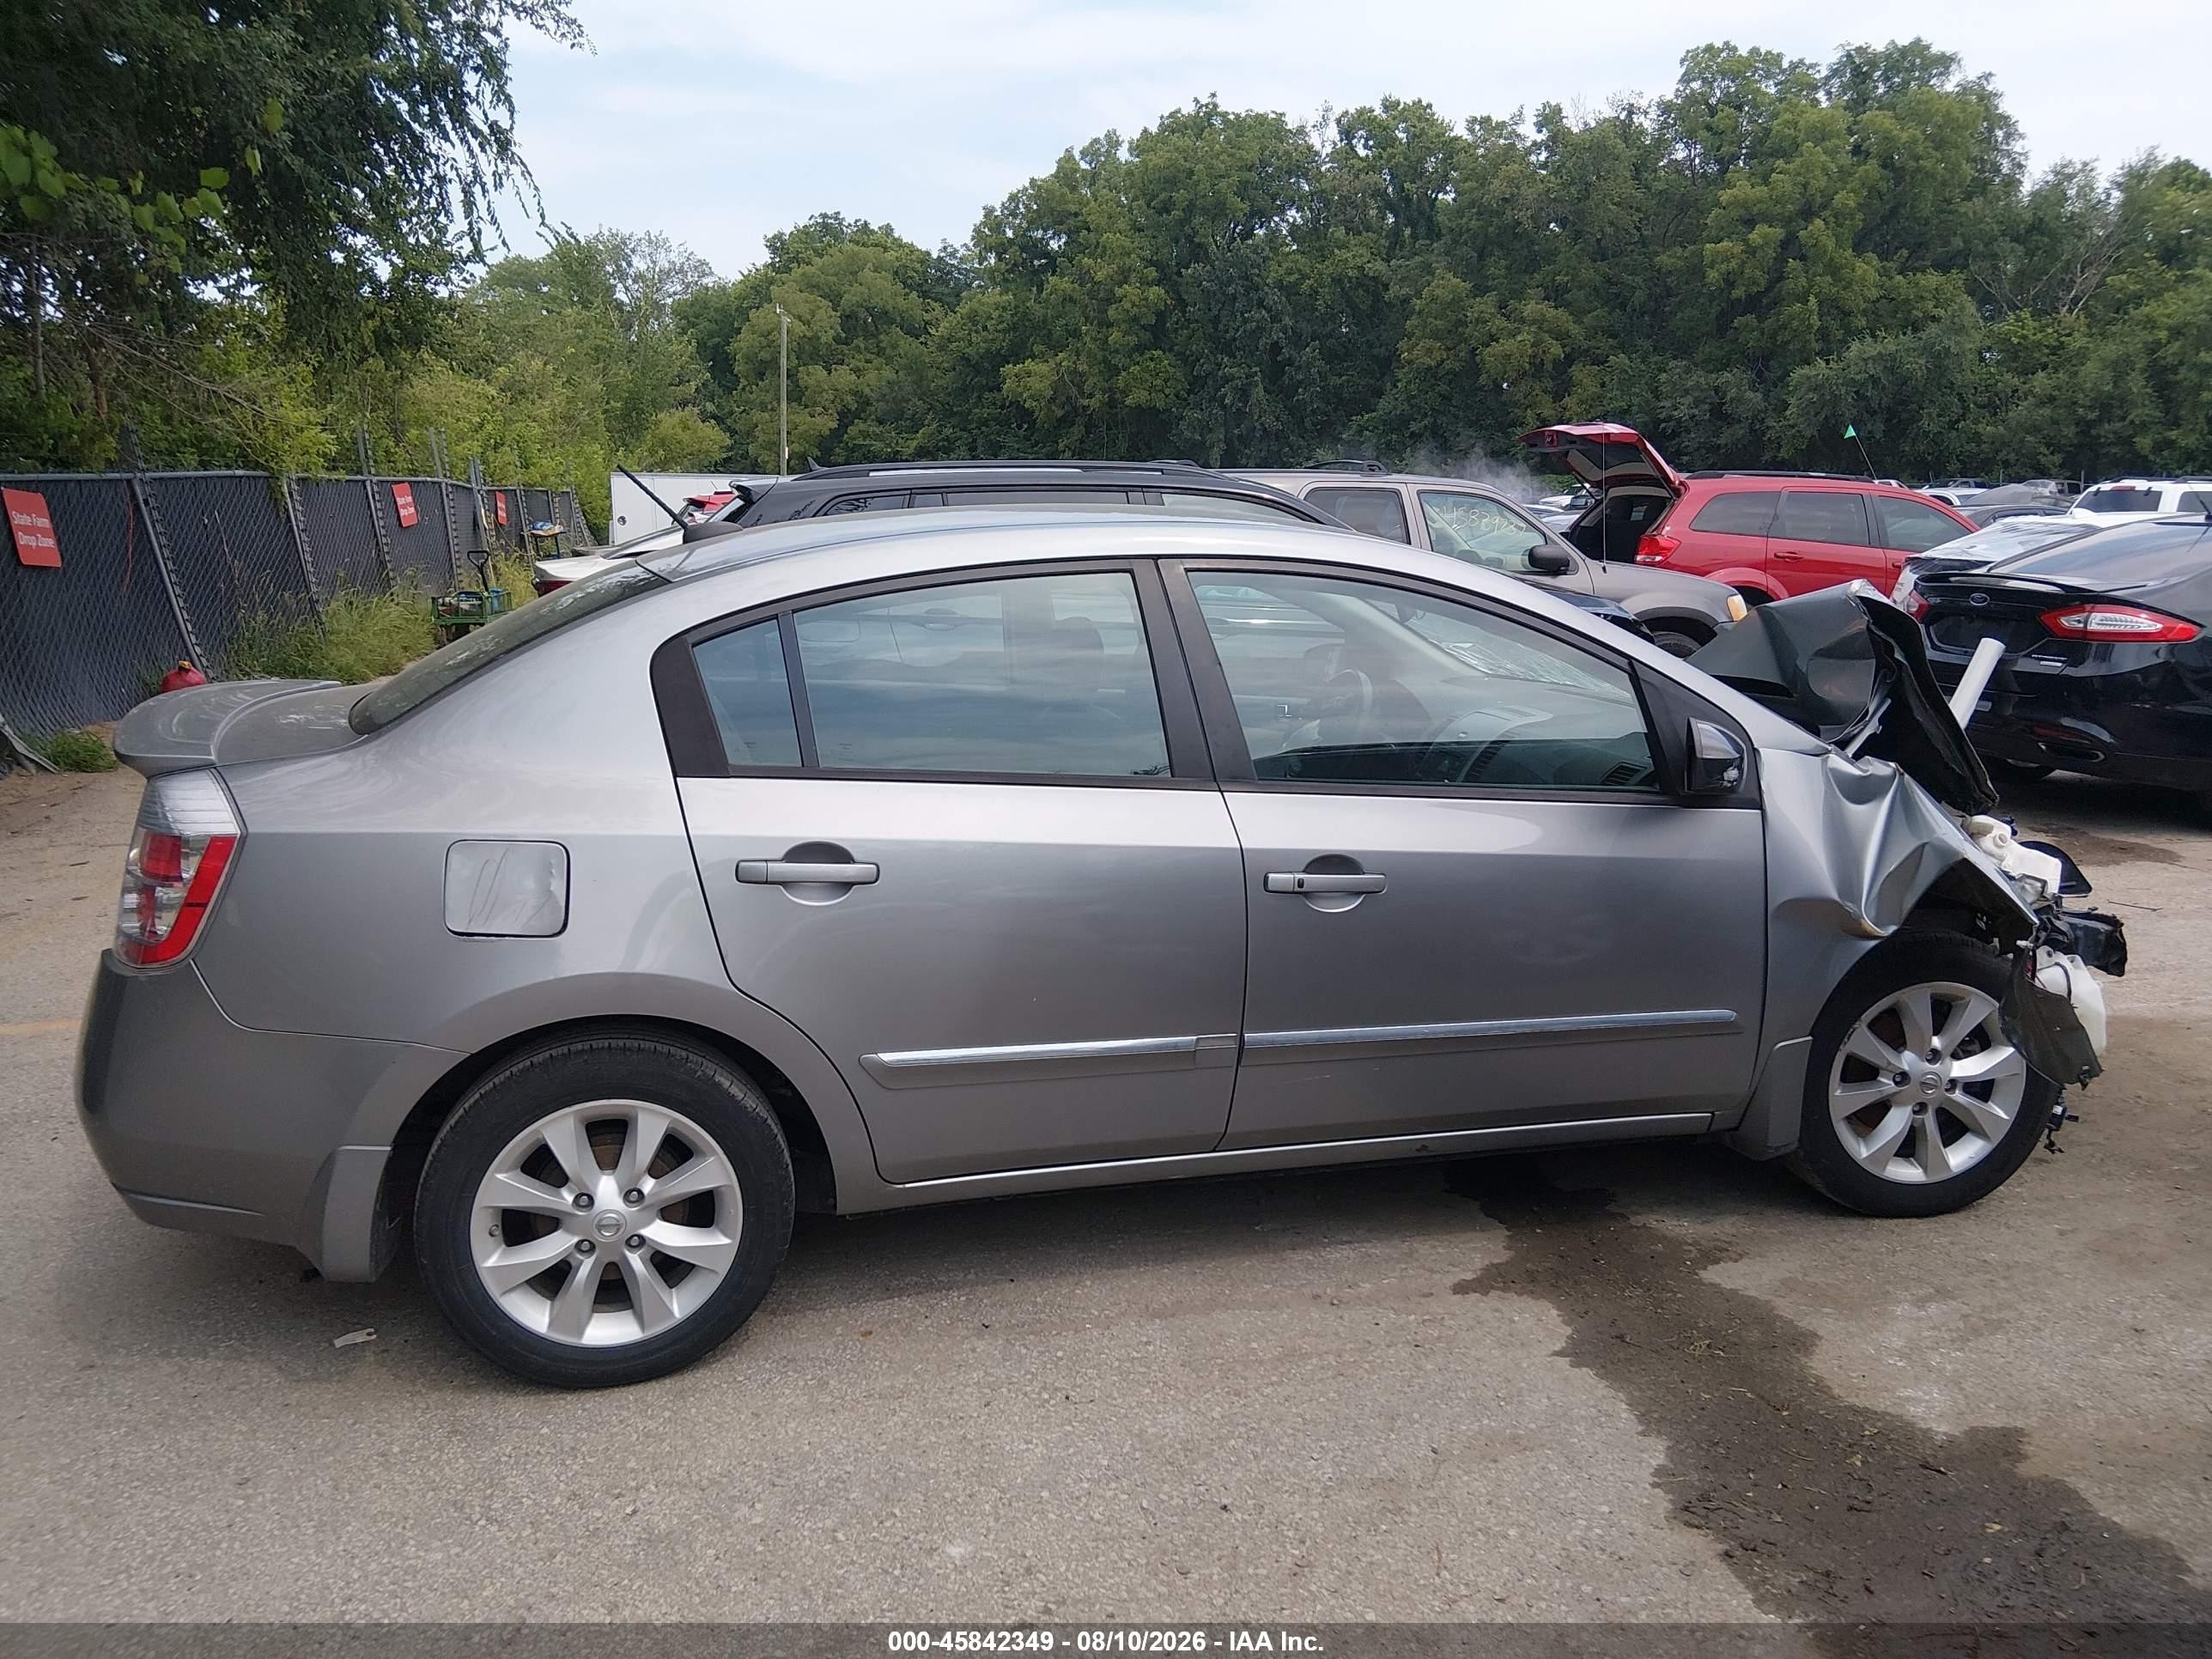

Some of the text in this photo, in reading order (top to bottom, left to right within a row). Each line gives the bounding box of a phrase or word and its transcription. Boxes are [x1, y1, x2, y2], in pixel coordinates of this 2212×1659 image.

[12, 511, 50, 528] State Farm
[18, 532, 55, 550] Drop Zone
